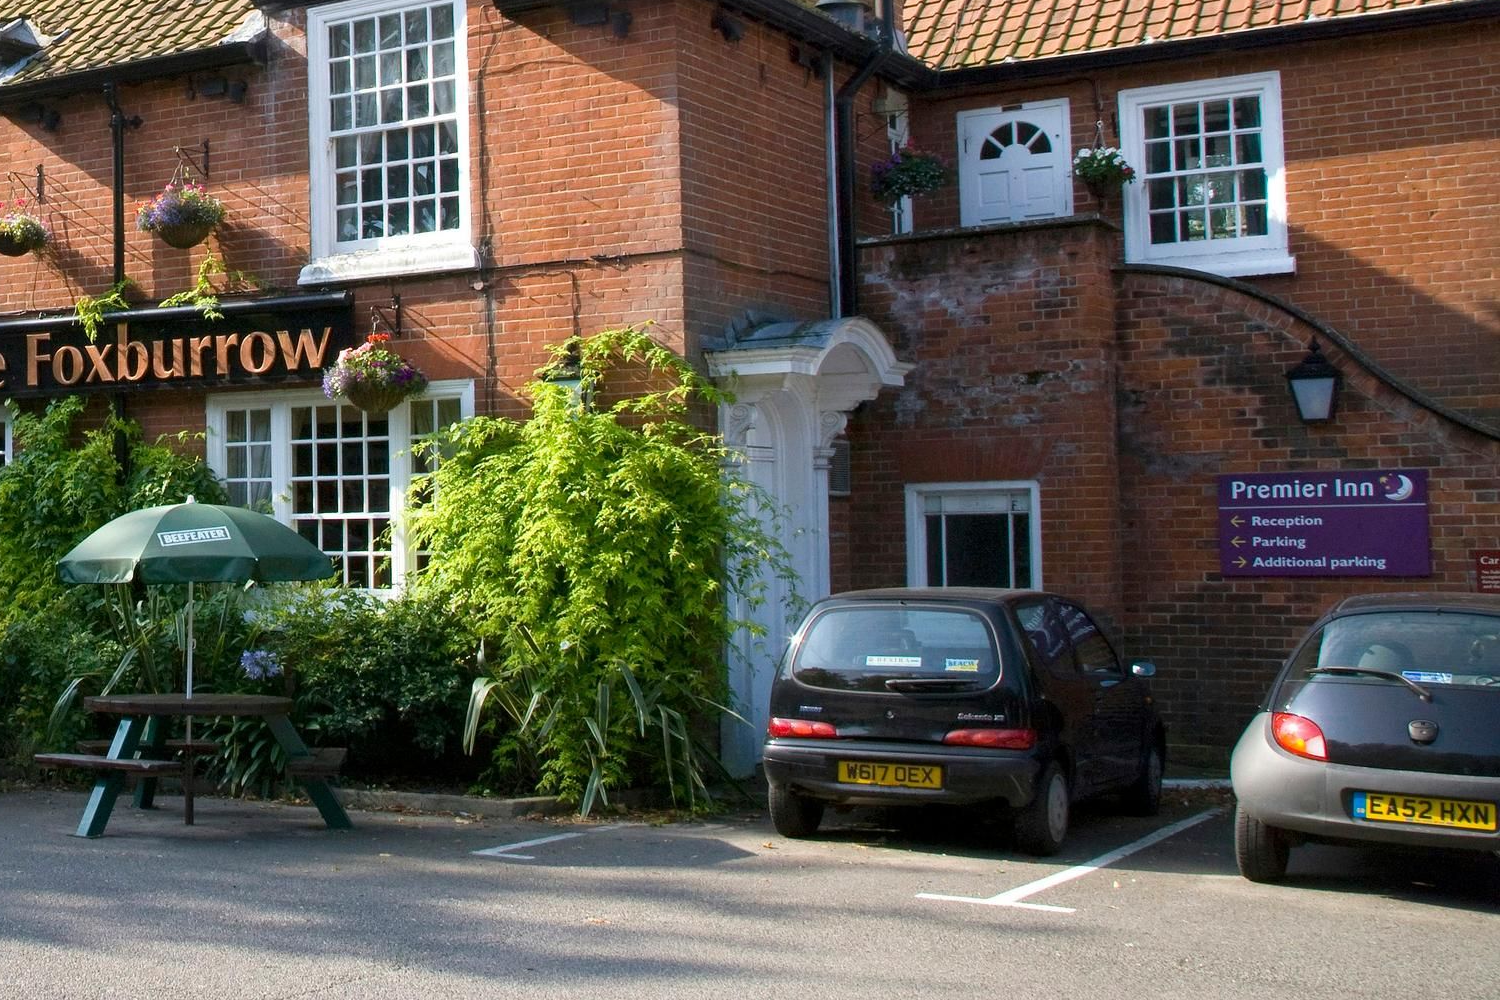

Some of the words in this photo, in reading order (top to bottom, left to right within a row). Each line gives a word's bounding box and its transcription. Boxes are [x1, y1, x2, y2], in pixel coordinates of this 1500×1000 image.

[25, 322, 332, 387] Foxburrow
[1231, 480, 1328, 499] Premier
[1335, 478, 1374, 498] Inn
[1251, 515, 1323, 528] Reception
[163, 529, 226, 544] BEEFEATER
[1252, 536, 1306, 549] Parking
[1252, 556, 1326, 568] Additional
[1330, 556, 1386, 570] parking
[1480, 556, 1500, 565] Car
[846, 763, 888, 781] W617
[894, 766, 934, 784] OEX
[1369, 795, 1432, 819] EA52
[1440, 802, 1489, 825] HXN
